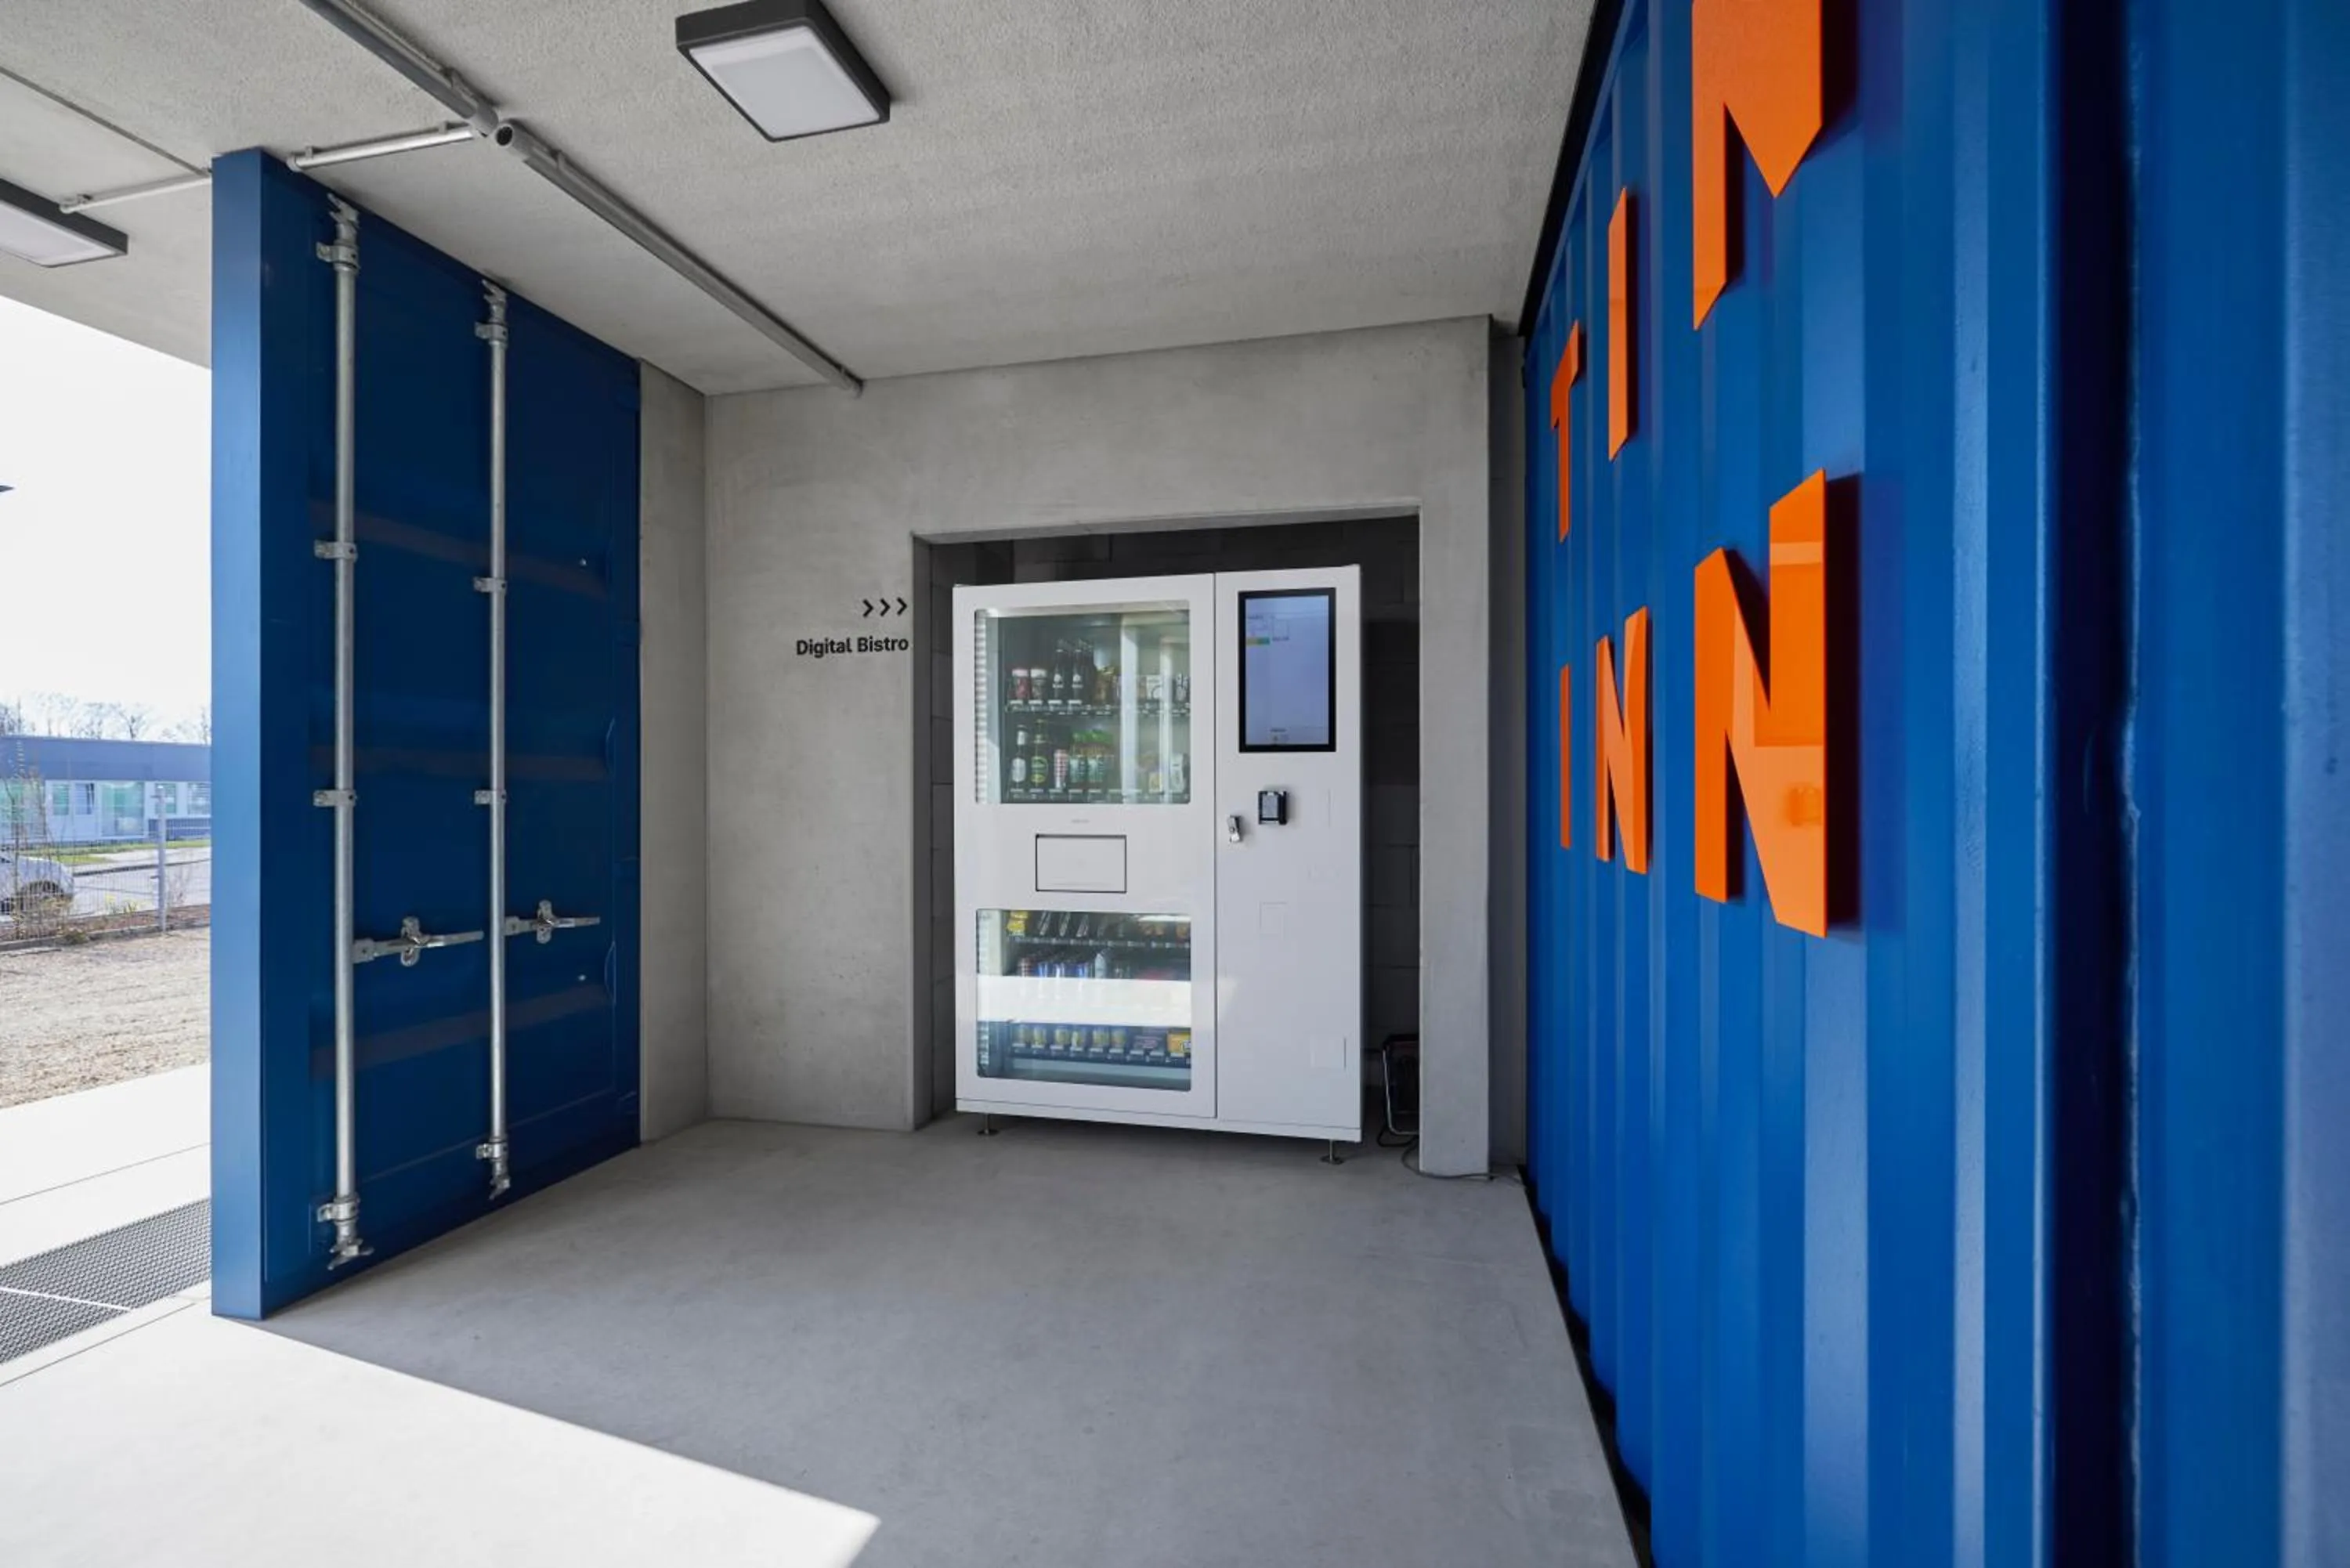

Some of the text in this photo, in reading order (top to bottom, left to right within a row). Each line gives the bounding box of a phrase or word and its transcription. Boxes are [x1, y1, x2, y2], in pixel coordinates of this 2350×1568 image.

[796, 635, 909, 659] Digital Bistro
[1560, 468, 1828, 937] INN
